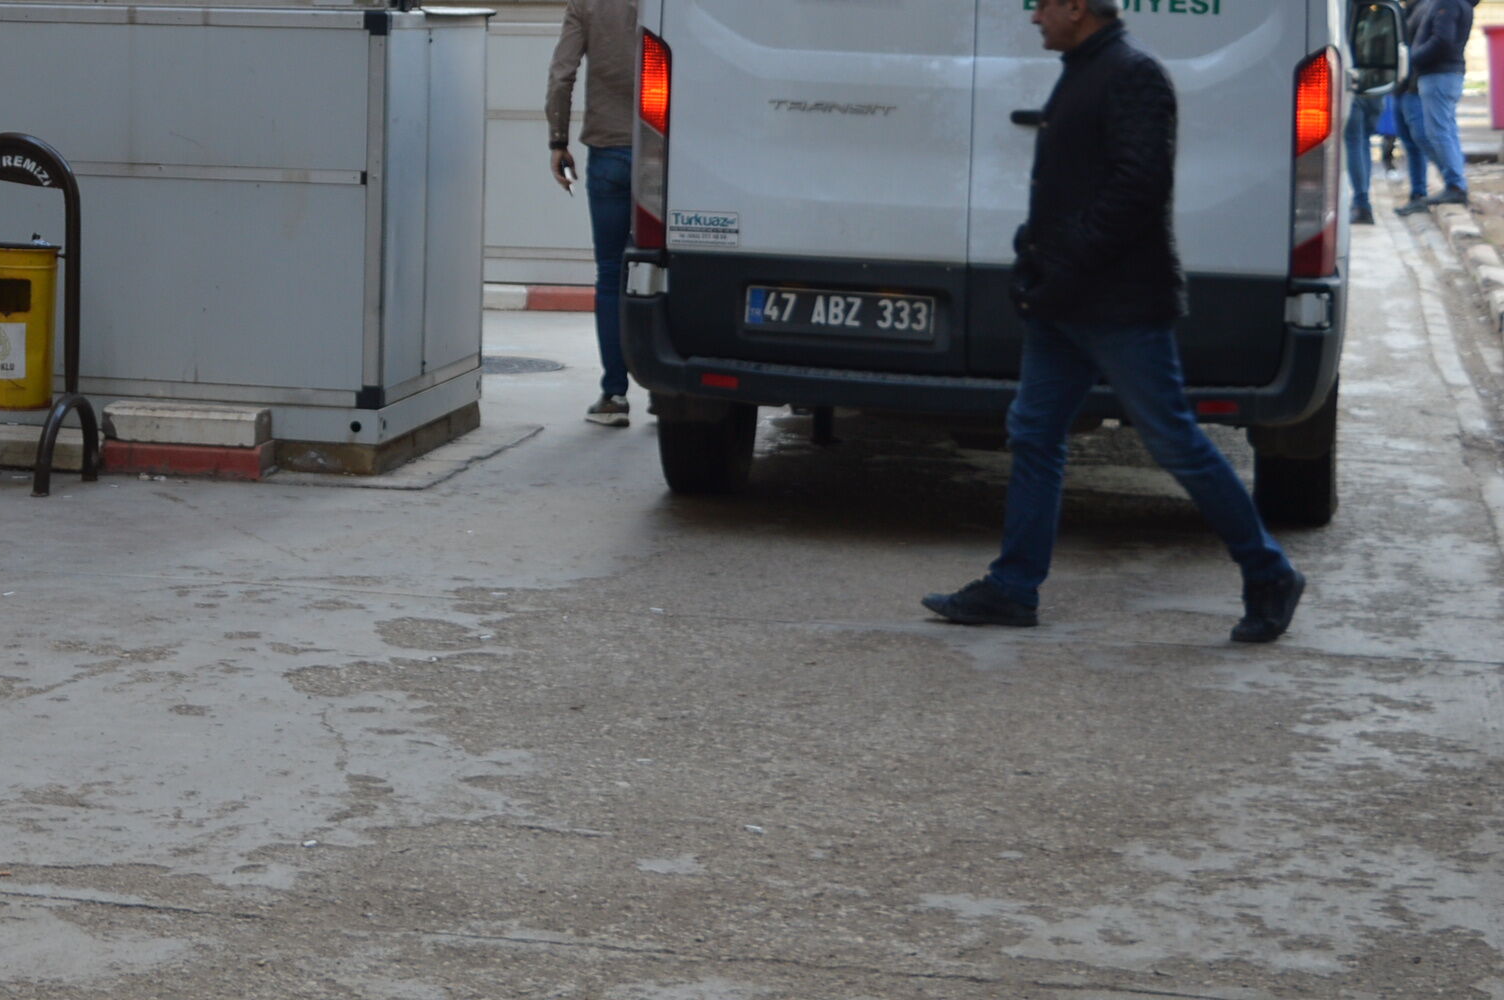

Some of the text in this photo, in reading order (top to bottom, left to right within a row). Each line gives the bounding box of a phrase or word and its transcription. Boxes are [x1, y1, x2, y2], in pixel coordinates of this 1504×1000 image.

[763, 291, 797, 322] 47
[810, 295, 863, 327] ABZ
[876, 299, 929, 331] 333
